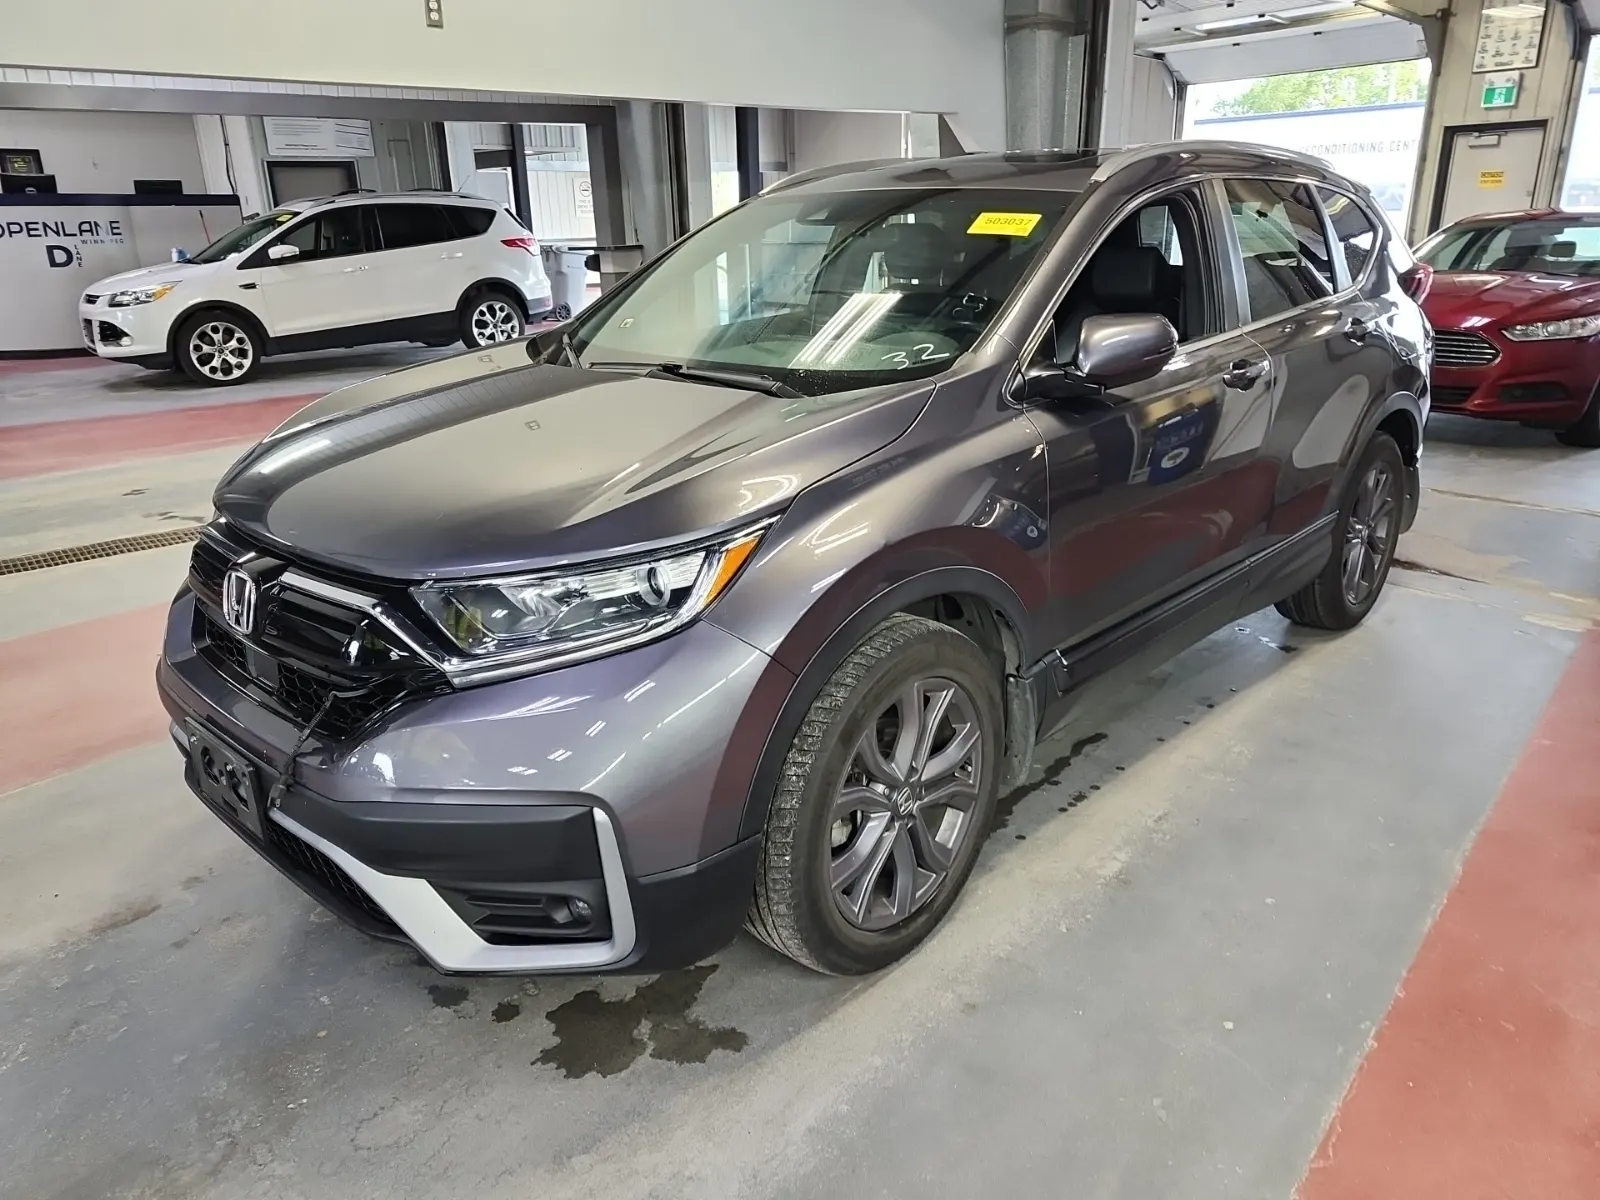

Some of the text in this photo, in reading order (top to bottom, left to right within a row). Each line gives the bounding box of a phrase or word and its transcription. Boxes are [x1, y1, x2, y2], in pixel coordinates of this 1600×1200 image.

[1389, 139, 1417, 152] CENT
[984, 217, 1032, 226] 503037
[45, 244, 84, 268] D LANE
